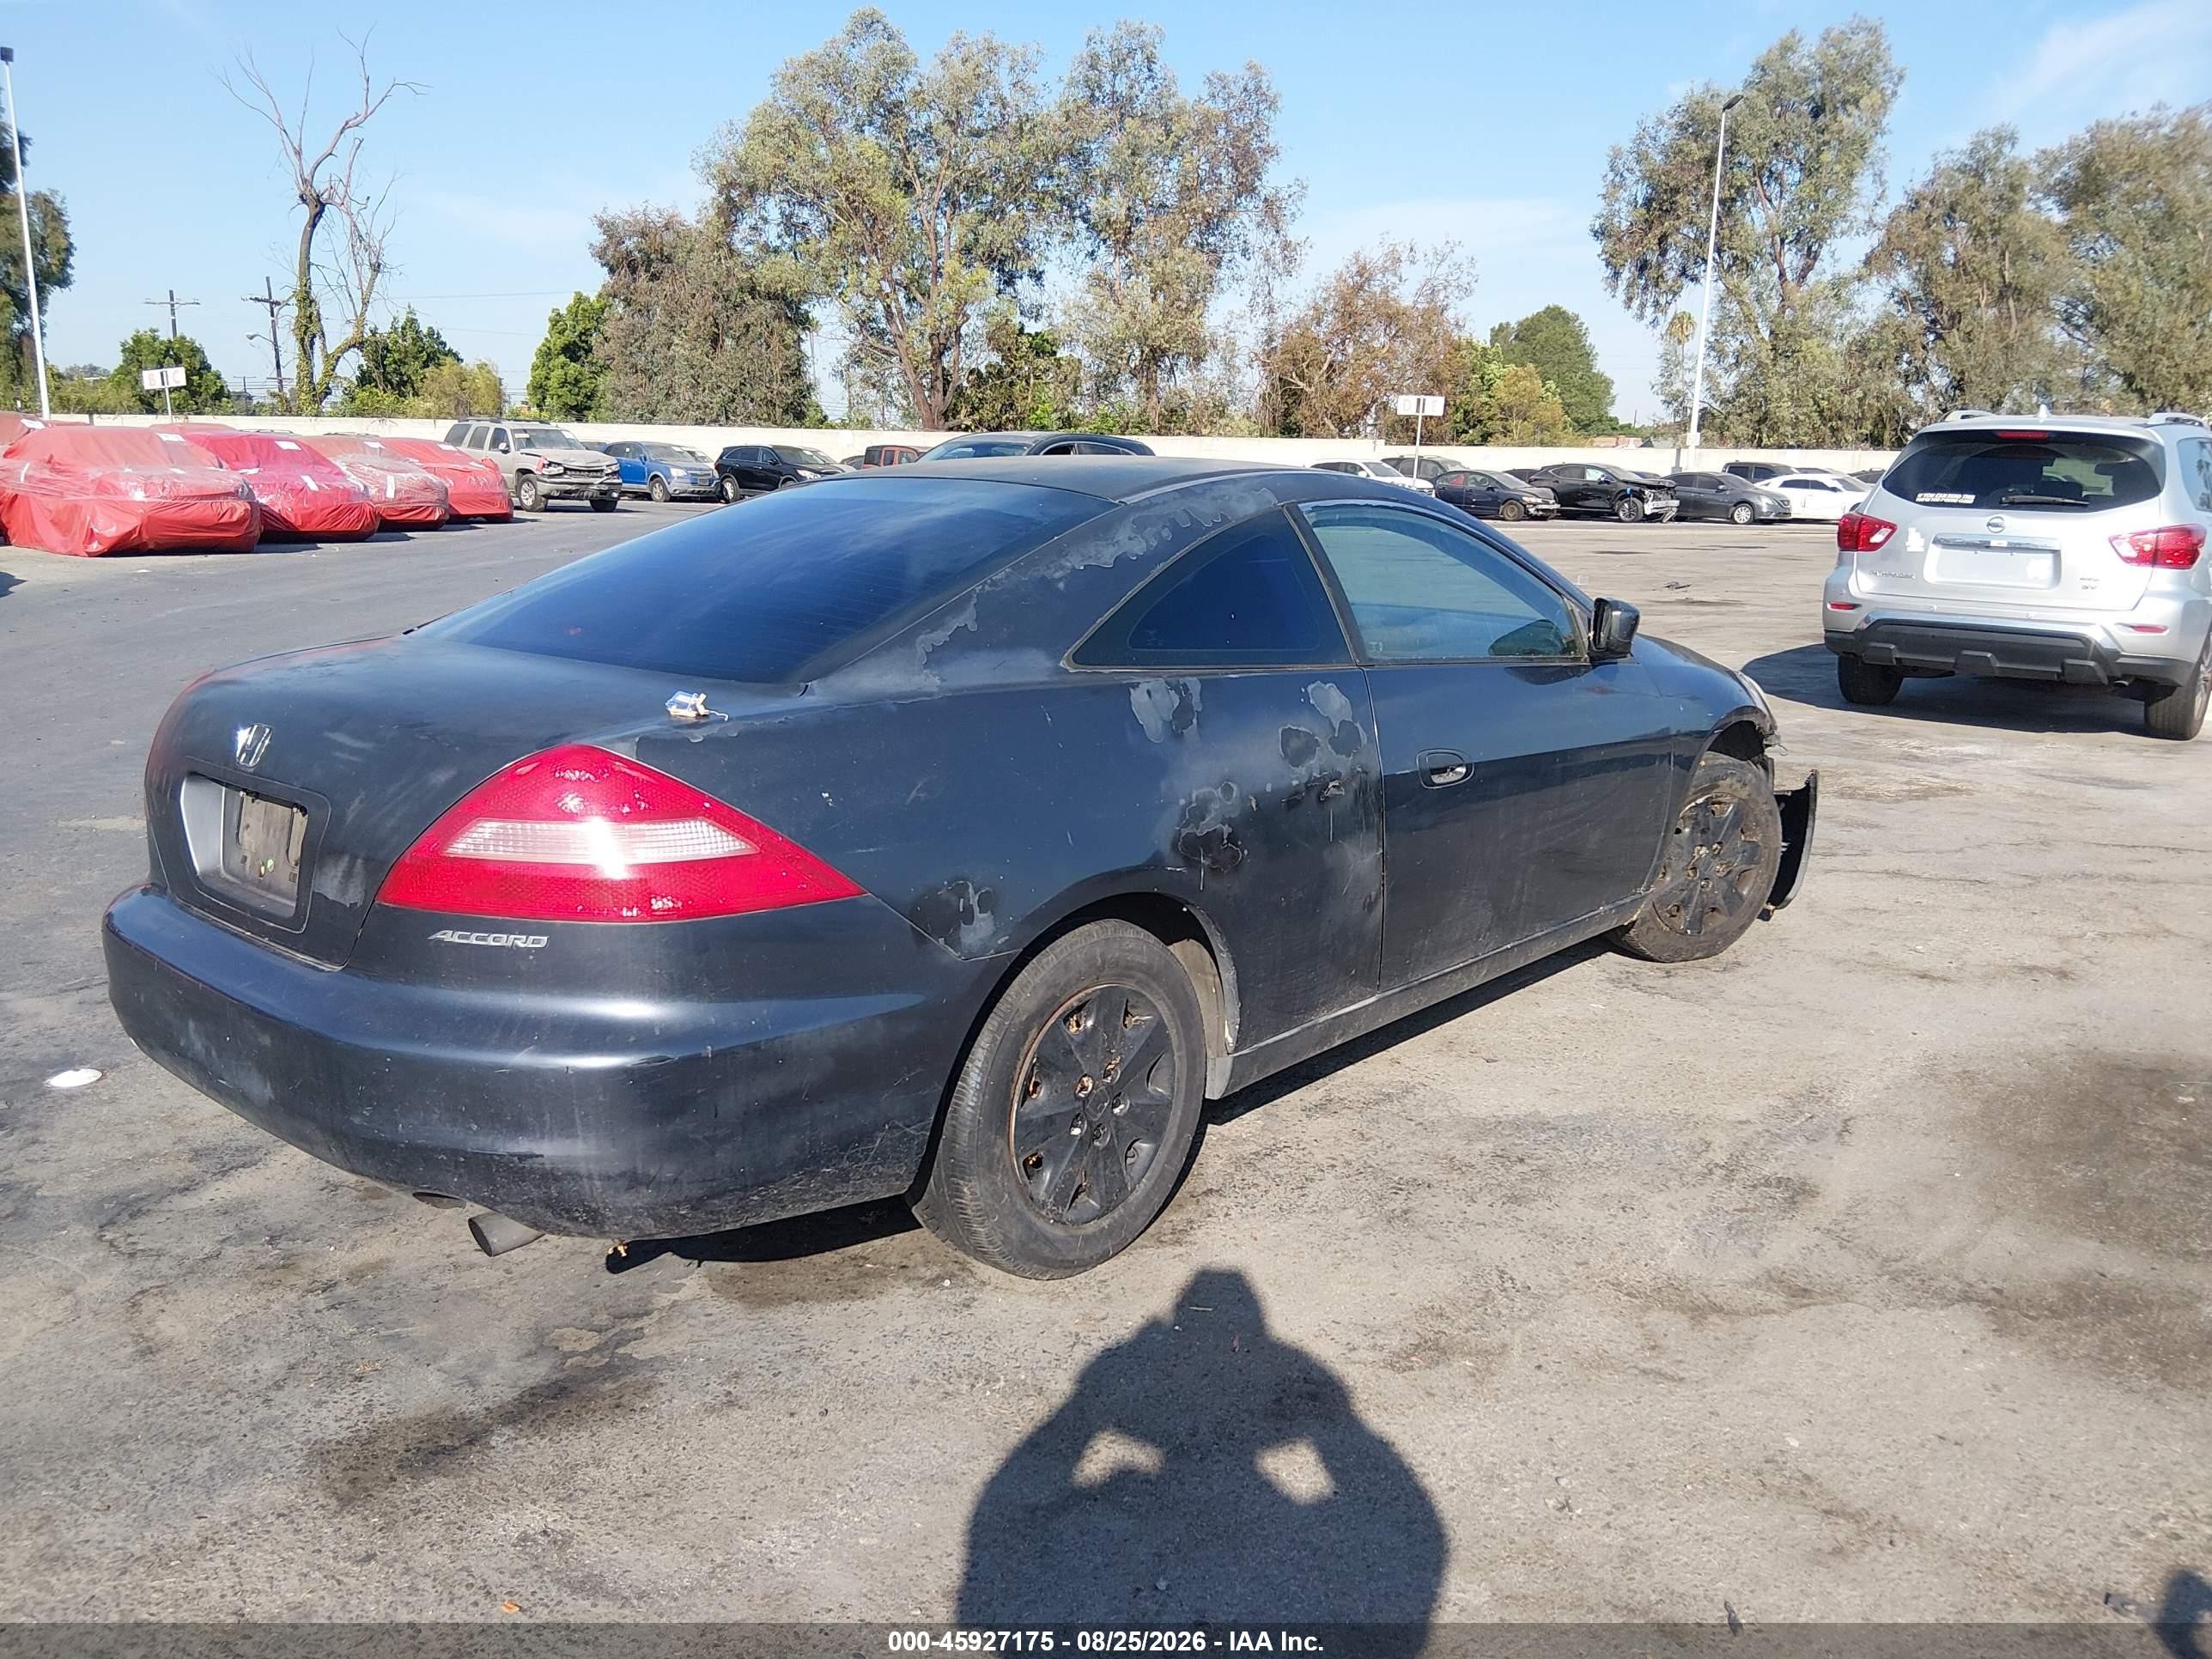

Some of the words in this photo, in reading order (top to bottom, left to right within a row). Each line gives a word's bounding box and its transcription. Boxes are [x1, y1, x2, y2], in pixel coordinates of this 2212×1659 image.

[148, 373, 156, 386] B
[172, 370, 181, 384] C
[426, 929, 550, 949] ACCORD
